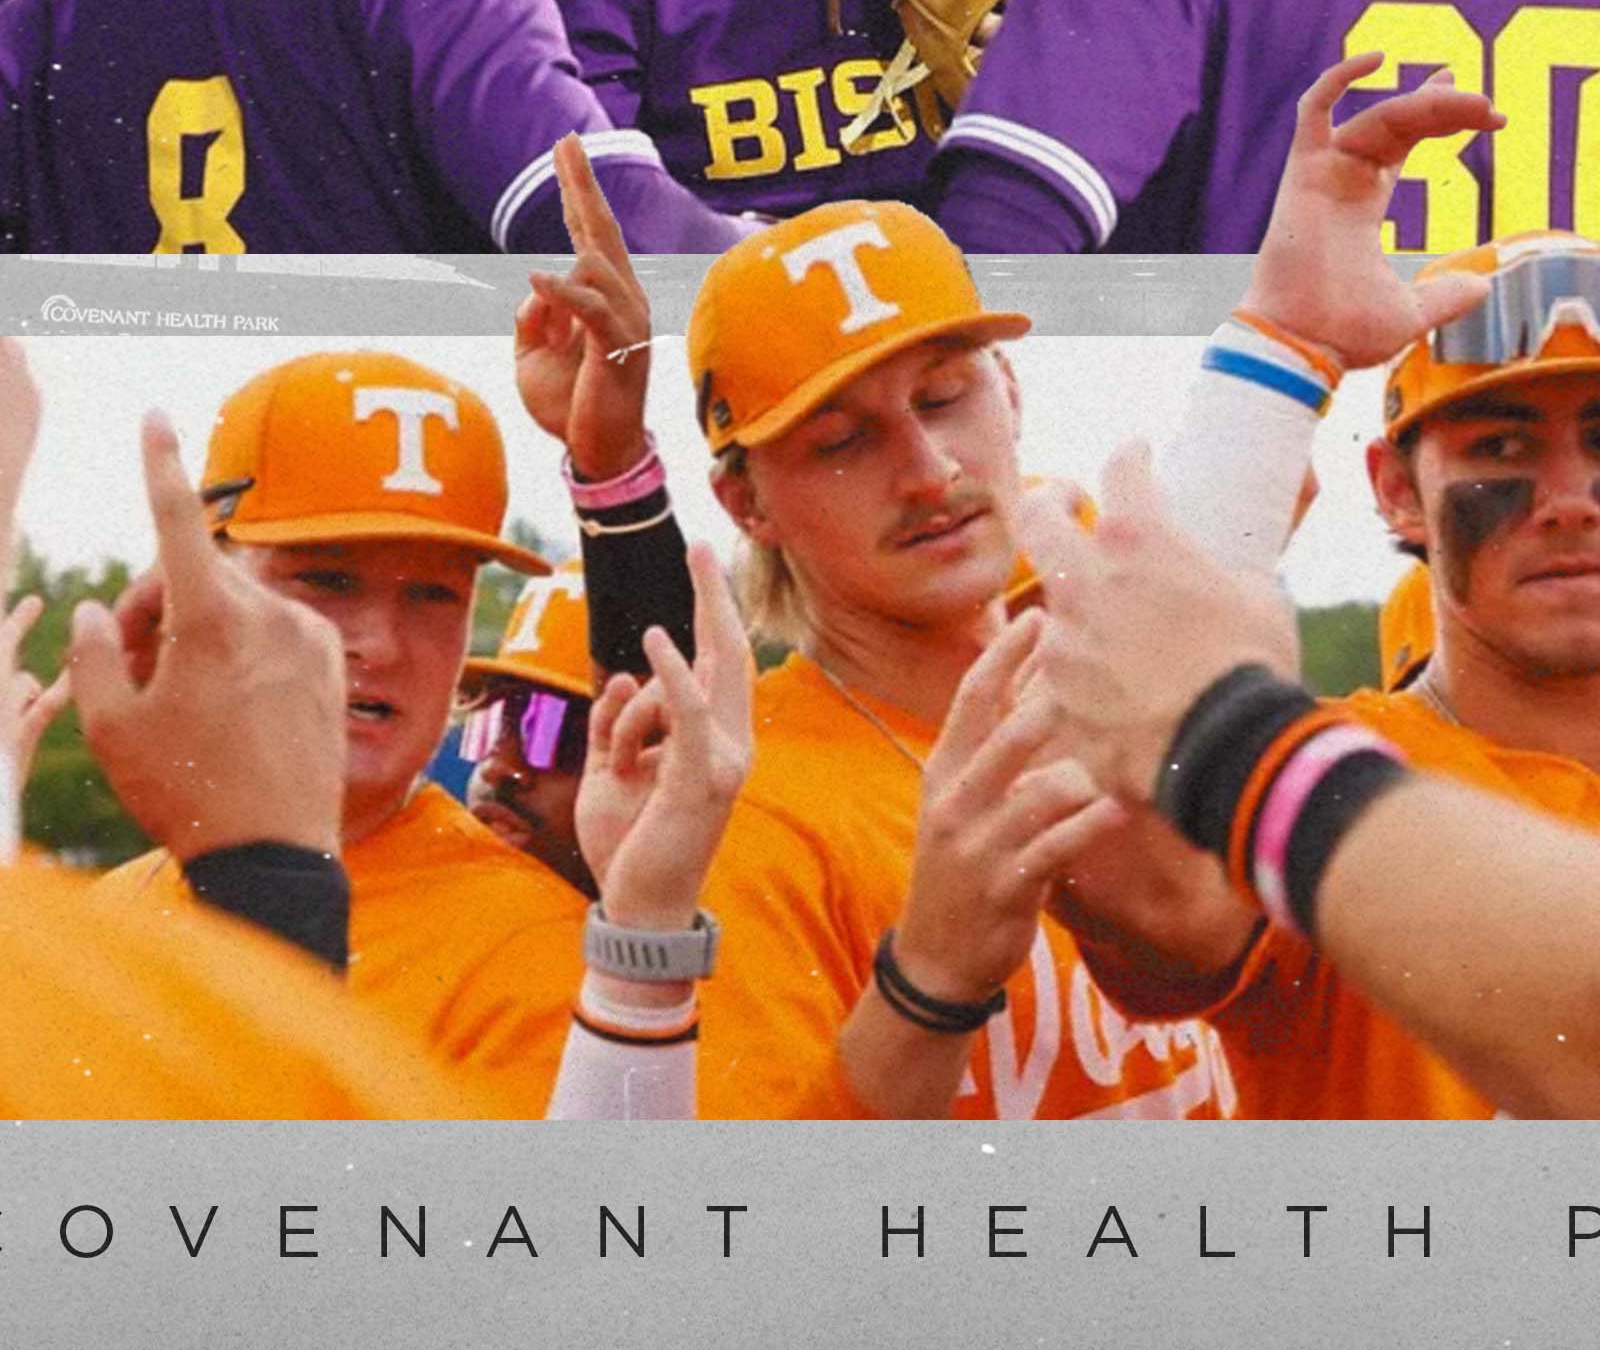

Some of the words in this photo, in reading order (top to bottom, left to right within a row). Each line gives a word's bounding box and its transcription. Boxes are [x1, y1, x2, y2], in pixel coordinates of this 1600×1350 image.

[146, 76, 246, 254] 8
[690, 59, 916, 180] BIS
[50, 305, 151, 327] COVENANT
[156, 311, 227, 329] HEALTH
[233, 314, 280, 332] PARK
[782, 220, 901, 334] T
[353, 386, 459, 496] T
[504, 570, 585, 654] T
